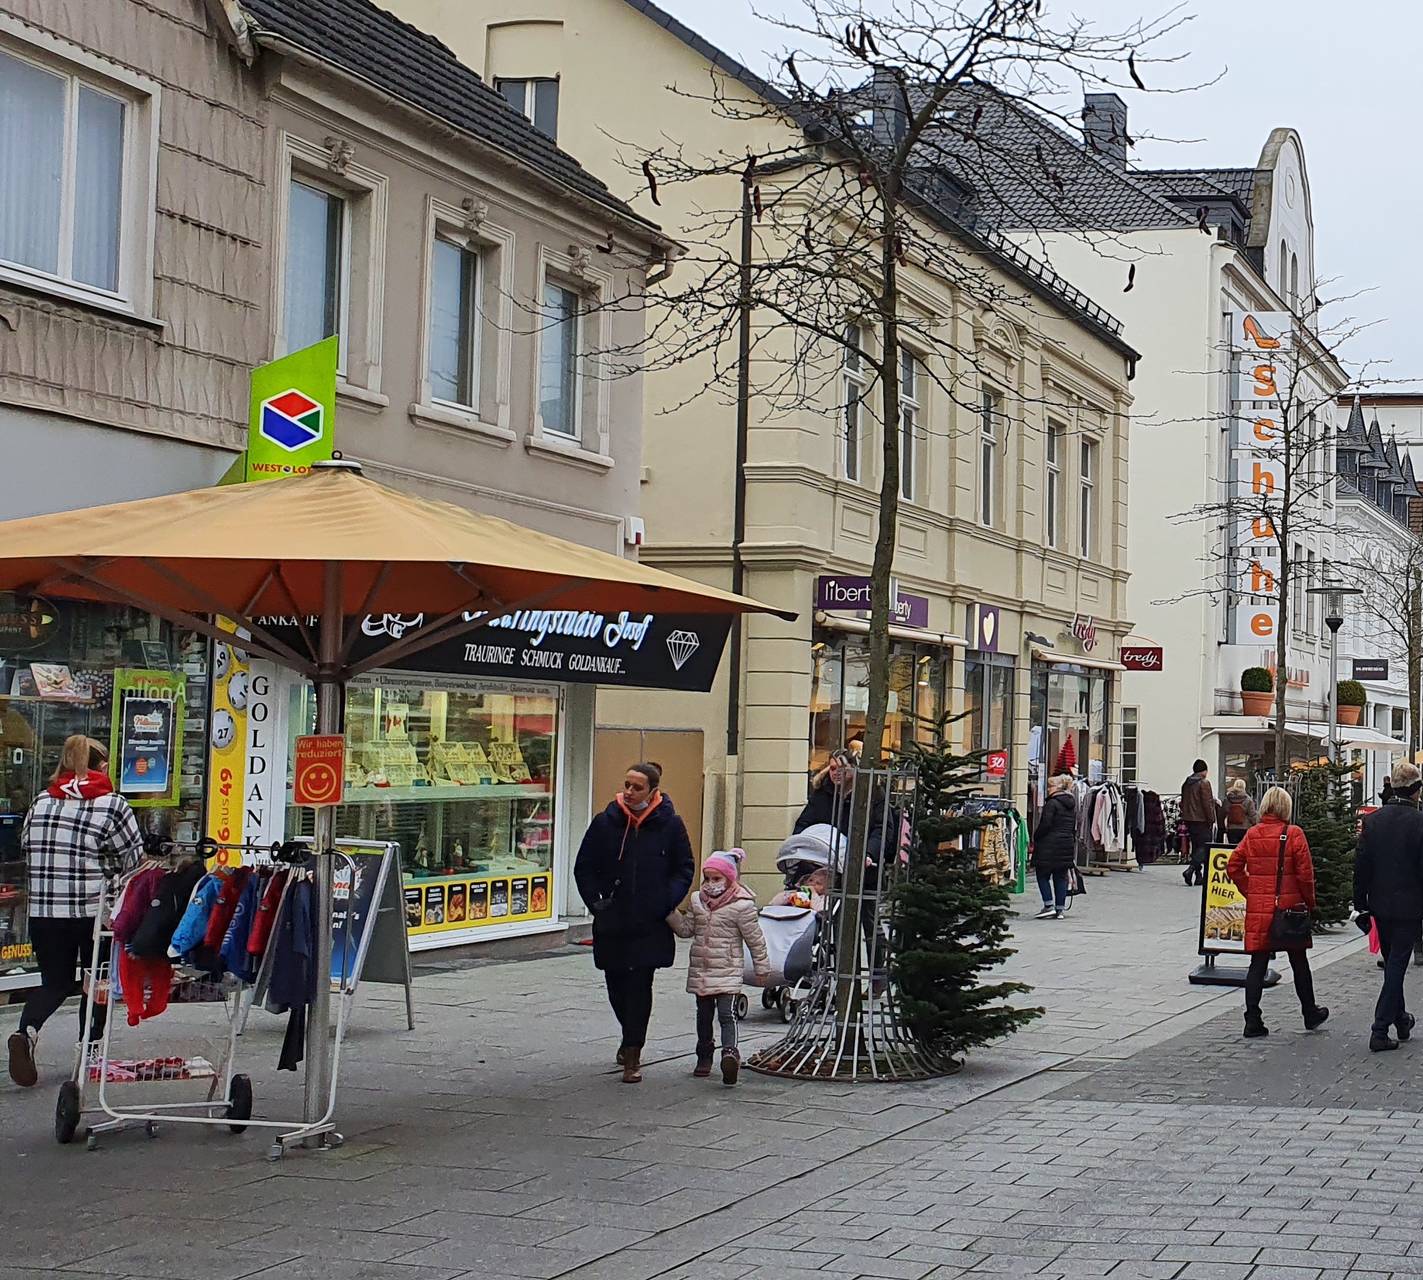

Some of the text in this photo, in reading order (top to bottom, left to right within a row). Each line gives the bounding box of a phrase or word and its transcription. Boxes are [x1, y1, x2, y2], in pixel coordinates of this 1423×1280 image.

[252, 463, 282, 473] WEST
[258, 615, 318, 627] ANKAF
[1071, 613, 1096, 652] tredy
[464, 643, 516, 665] TRAURINGE
[520, 649, 563, 669] SCHMUCK
[1123, 651, 1160, 667] tredy
[217, 728, 229, 740] 27
[316, 740, 344, 748] haben
[297, 749, 342, 758] reduziert
[1211, 885, 1235, 900] HIER
